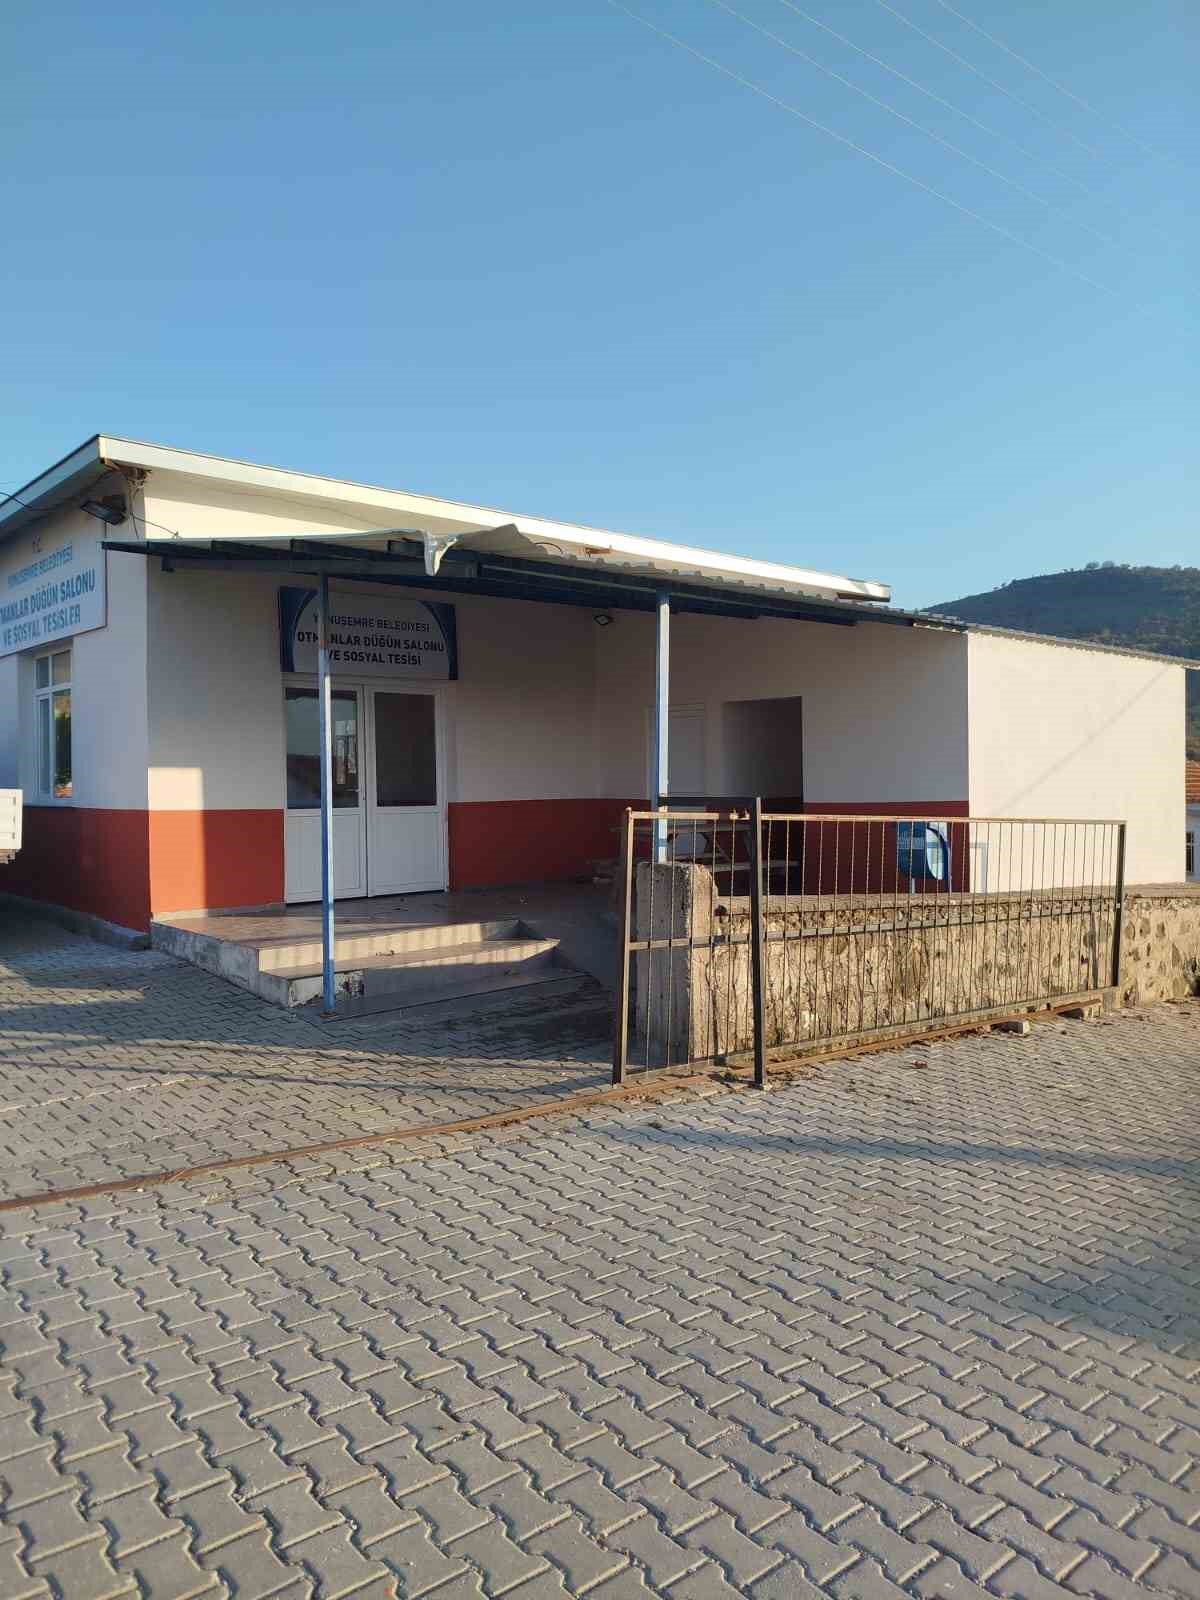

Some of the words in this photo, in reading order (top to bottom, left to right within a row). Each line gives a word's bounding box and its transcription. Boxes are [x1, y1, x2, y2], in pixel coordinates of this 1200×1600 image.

[60, 568, 96, 602] SALONU
[313, 613, 375, 628] YNUSEMRE
[297, 631, 360, 646] OTMNLAR
[363, 634, 401, 650] DÜĞÜN
[403, 639, 444, 652] SALONU
[343, 650, 385, 663] SOSYAL
